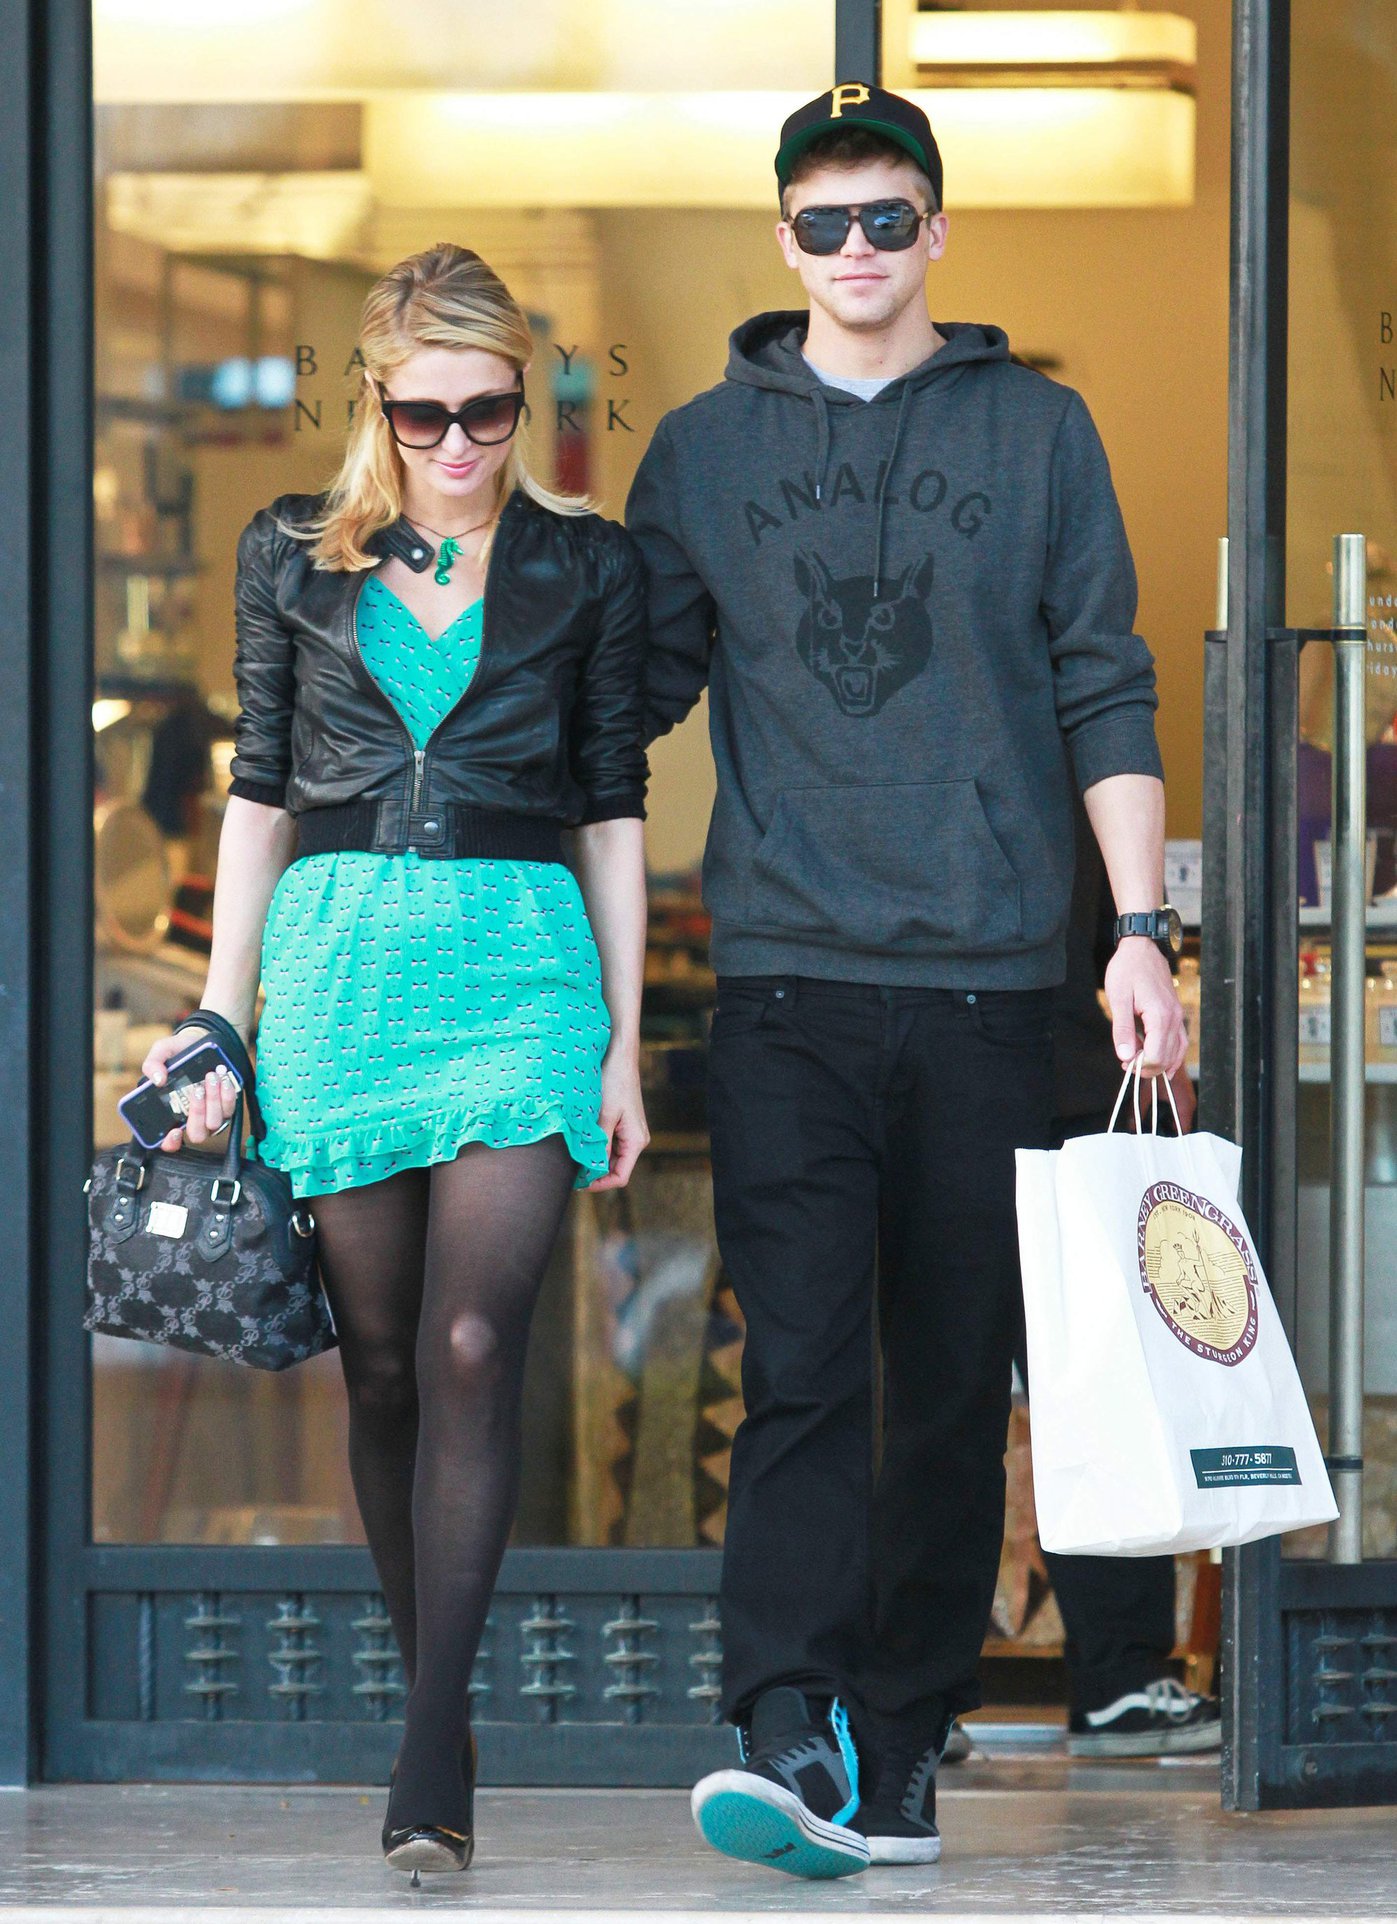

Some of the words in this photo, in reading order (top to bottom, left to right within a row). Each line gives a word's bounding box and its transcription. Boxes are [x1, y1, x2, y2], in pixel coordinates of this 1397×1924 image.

[830, 83, 870, 119] P
[295, 344, 629, 376] BAYS
[525, 400, 635, 433] RK
[744, 460, 992, 546] ANALOG
[1138, 1192, 1152, 1290] BARNEY
[1153, 1184, 1258, 1286] GREENGRASS
[1171, 1321, 1191, 1345] THE
[1197, 1344, 1243, 1363] STURGEON
[1242, 1317, 1256, 1348] KING
